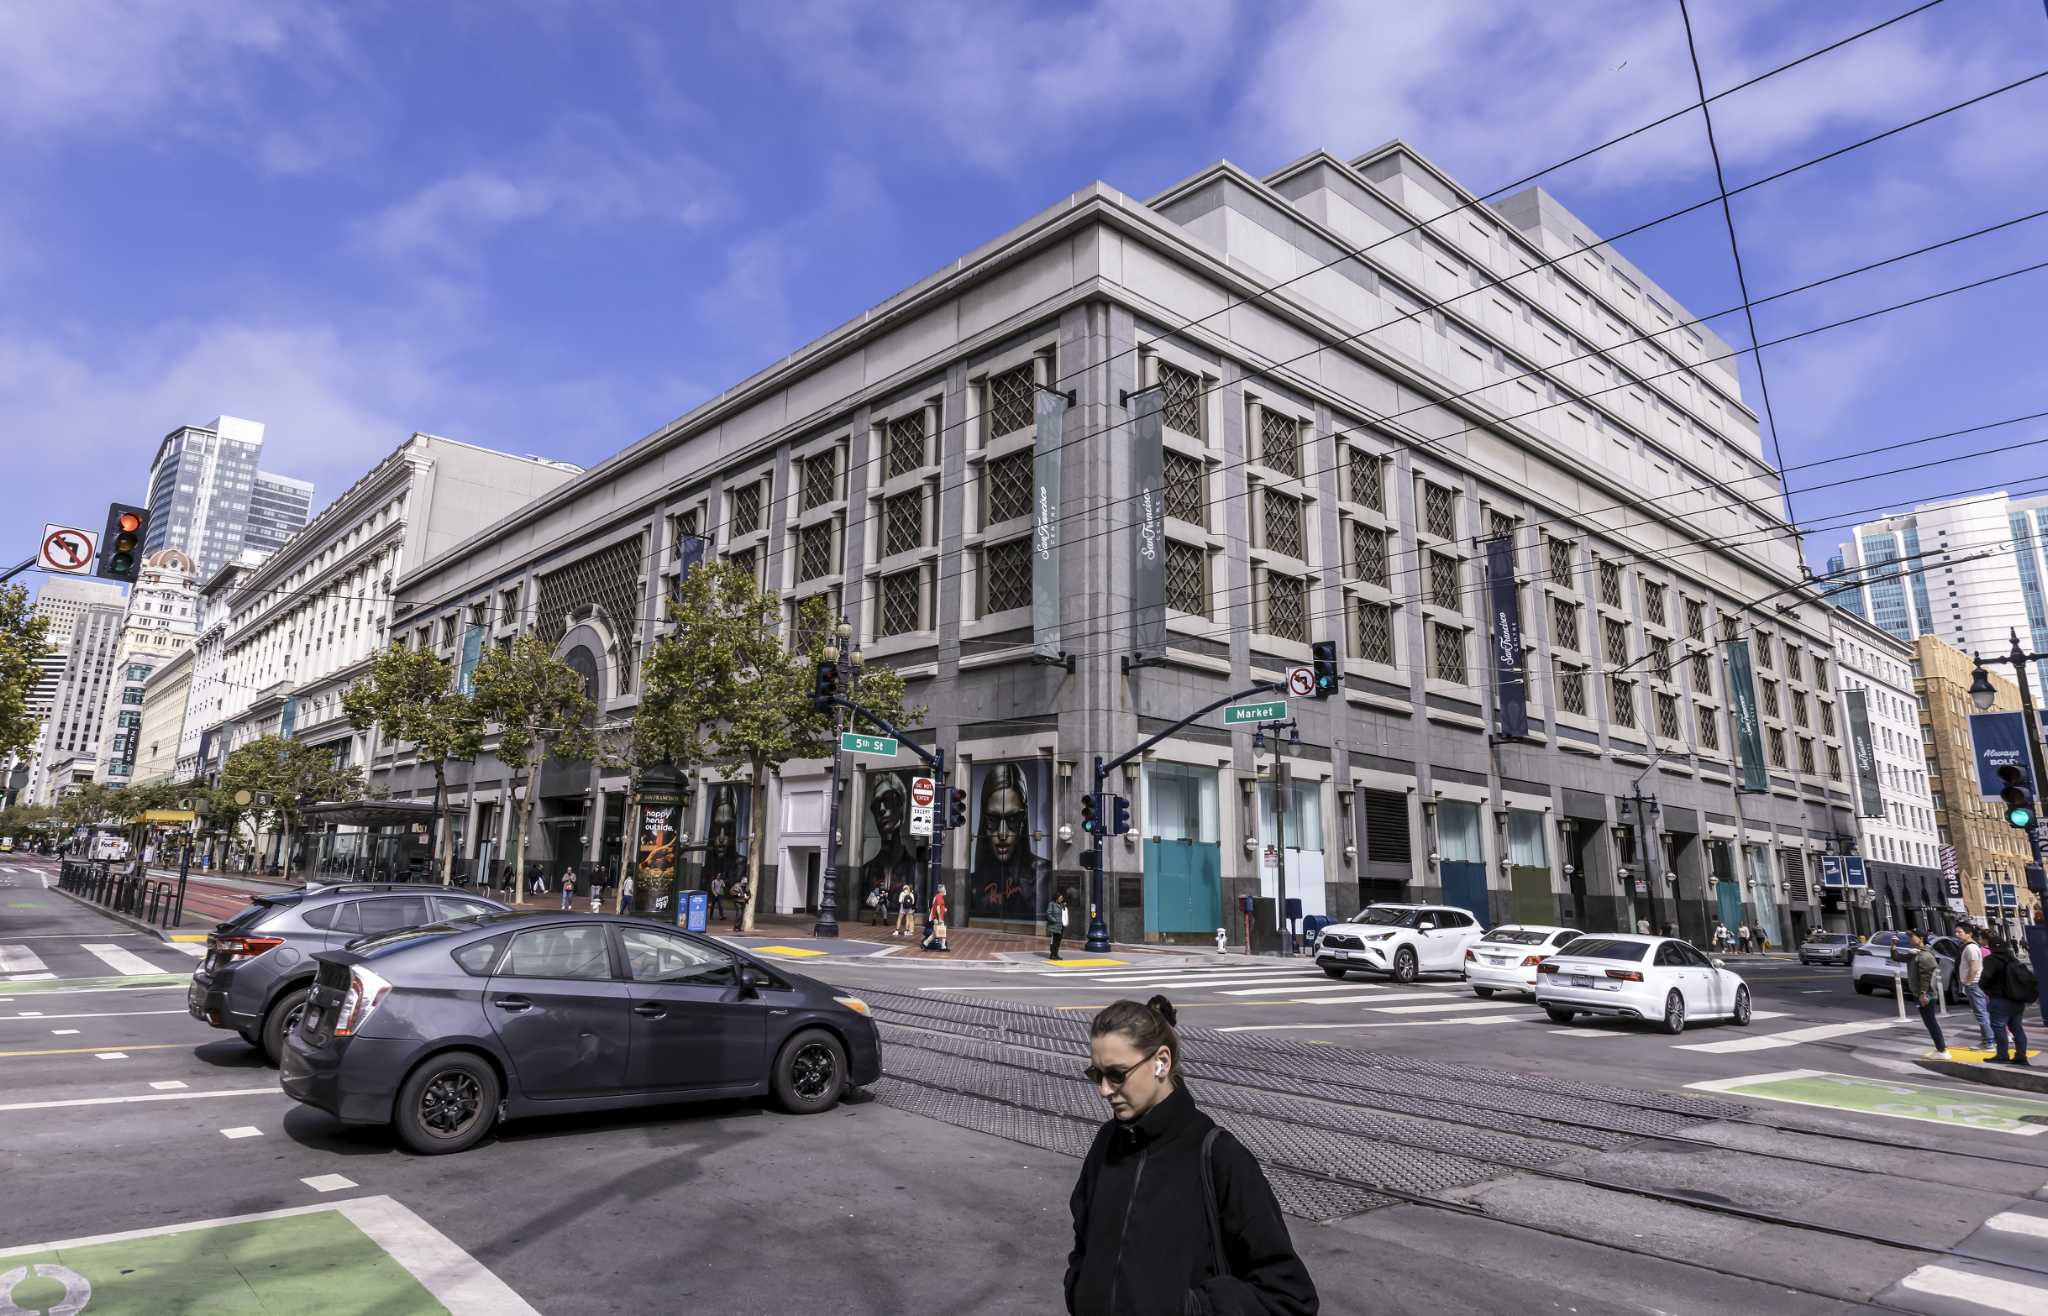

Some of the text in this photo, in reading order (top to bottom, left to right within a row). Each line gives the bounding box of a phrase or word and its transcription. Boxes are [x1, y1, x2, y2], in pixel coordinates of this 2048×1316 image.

[1236, 706, 1273, 719] Market
[856, 738, 884, 751] 5th St
[646, 808, 673, 818] happy
